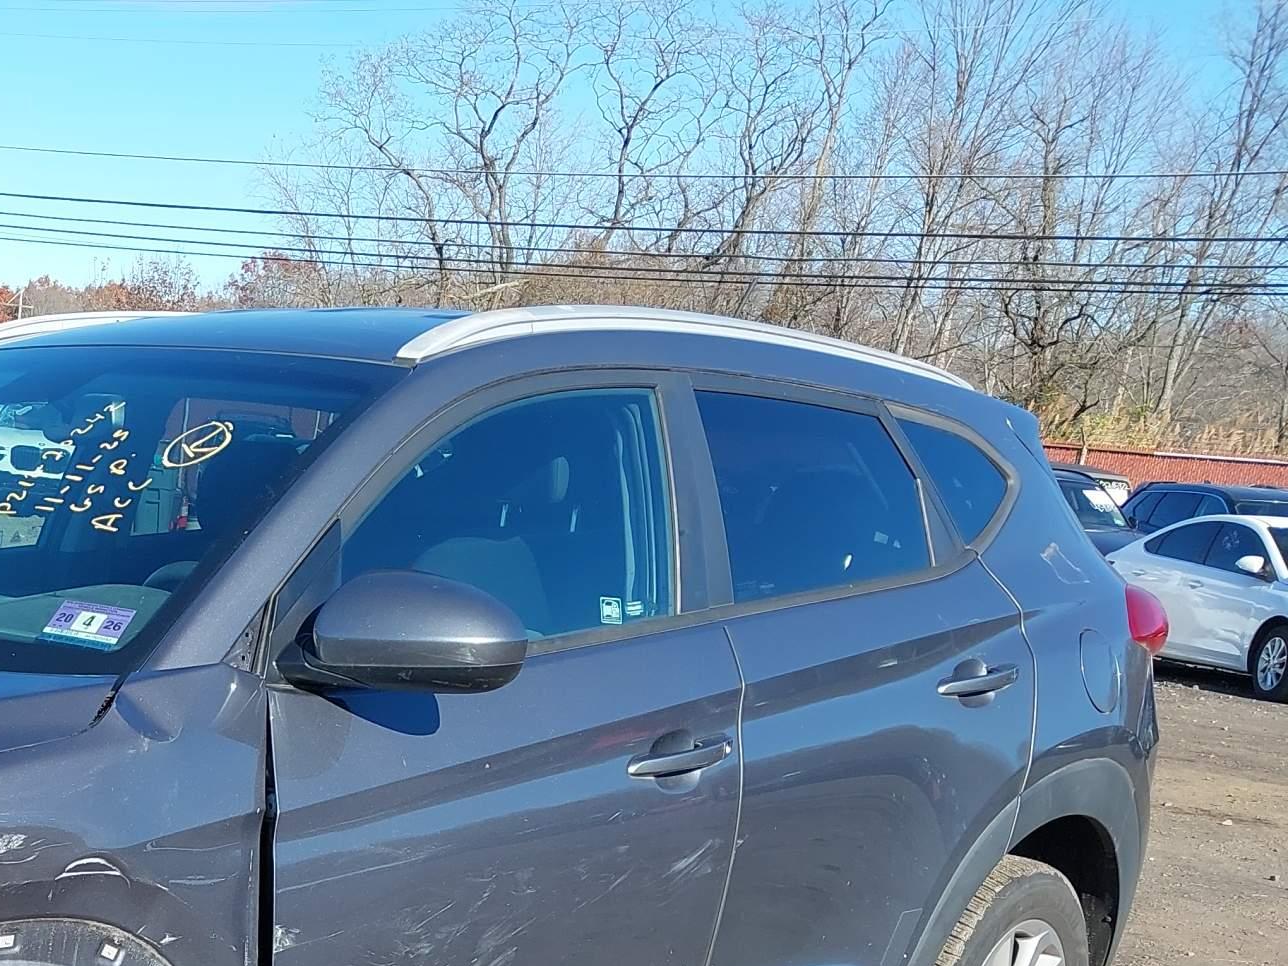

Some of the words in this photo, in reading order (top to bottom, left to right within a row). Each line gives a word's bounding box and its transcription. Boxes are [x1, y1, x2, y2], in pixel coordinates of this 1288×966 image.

[55, 612, 74, 624] 20
[82, 615, 97, 627] 4
[103, 620, 124, 632] 26
